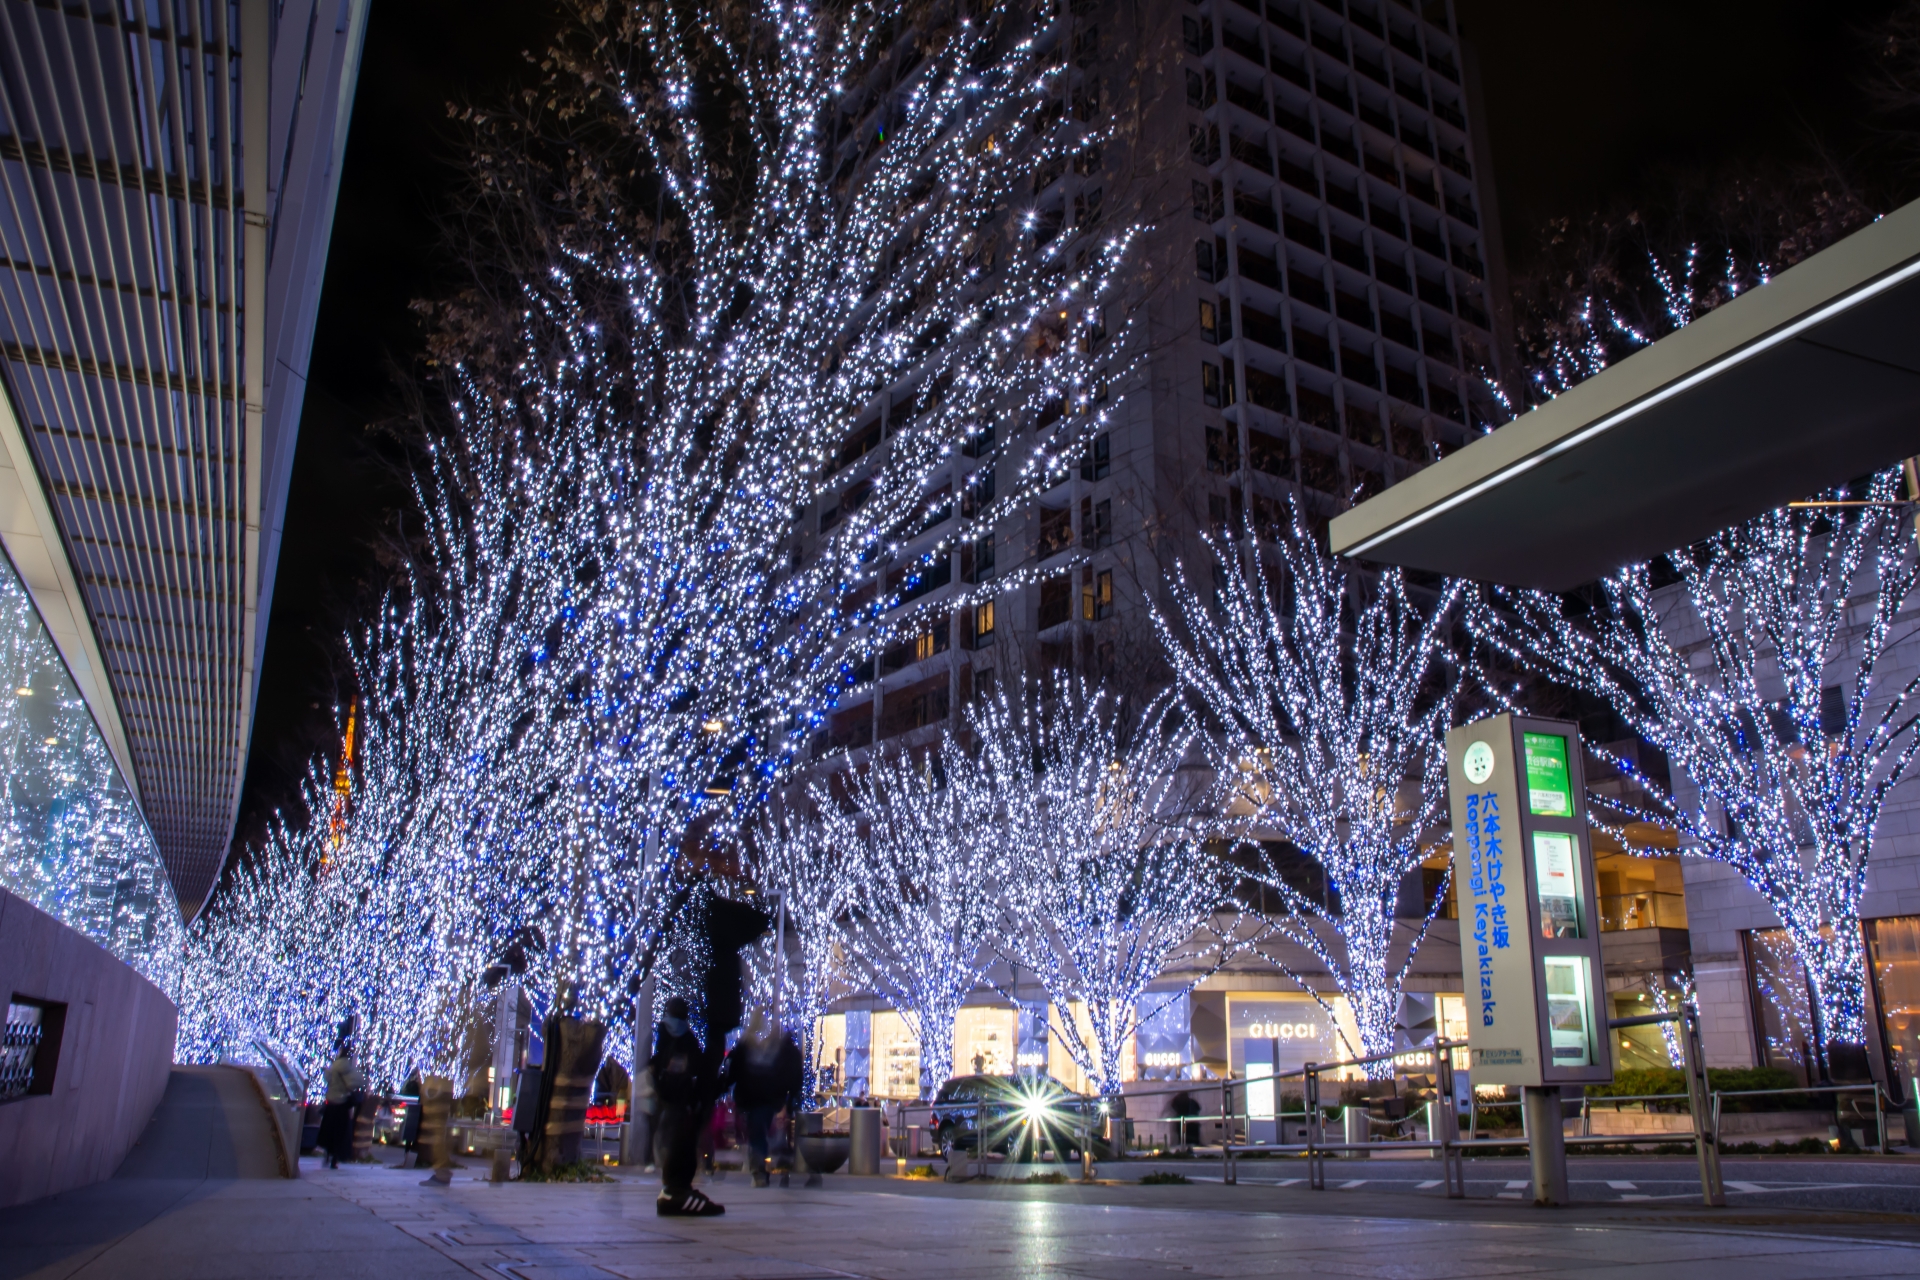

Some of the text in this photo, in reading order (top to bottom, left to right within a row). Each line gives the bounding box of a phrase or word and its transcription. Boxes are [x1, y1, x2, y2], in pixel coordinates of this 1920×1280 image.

[1465, 794, 1487, 897] Roppongi
[1482, 791, 1509, 949] 六本木けやき坂
[1474, 903, 1495, 1026] Keyakizaka
[1145, 1052, 1181, 1066] GUCCI
[1250, 1023, 1316, 1038] GUCCI
[1394, 1052, 1431, 1067] UCCI
